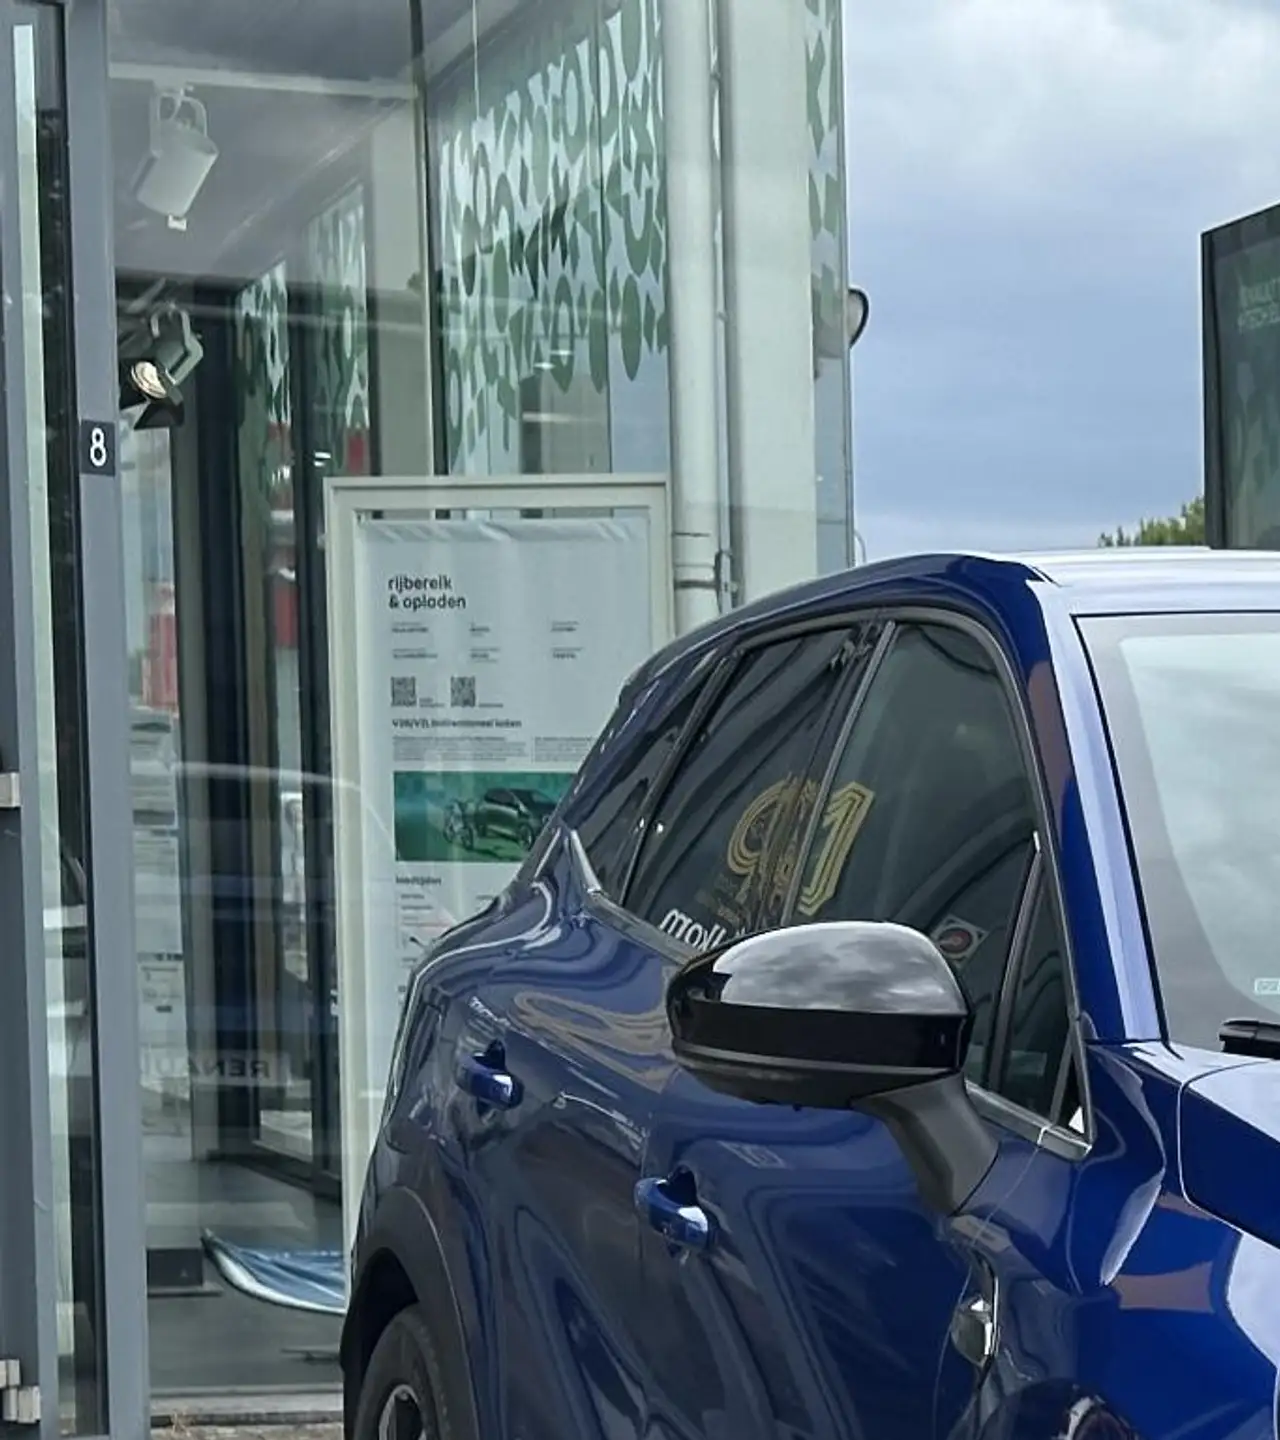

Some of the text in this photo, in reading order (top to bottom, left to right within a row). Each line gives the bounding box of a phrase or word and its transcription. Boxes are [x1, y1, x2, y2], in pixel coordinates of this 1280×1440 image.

[90, 427, 106, 467] 8
[387, 575, 453, 594] rijbereik
[388, 593, 467, 612] & opladen
